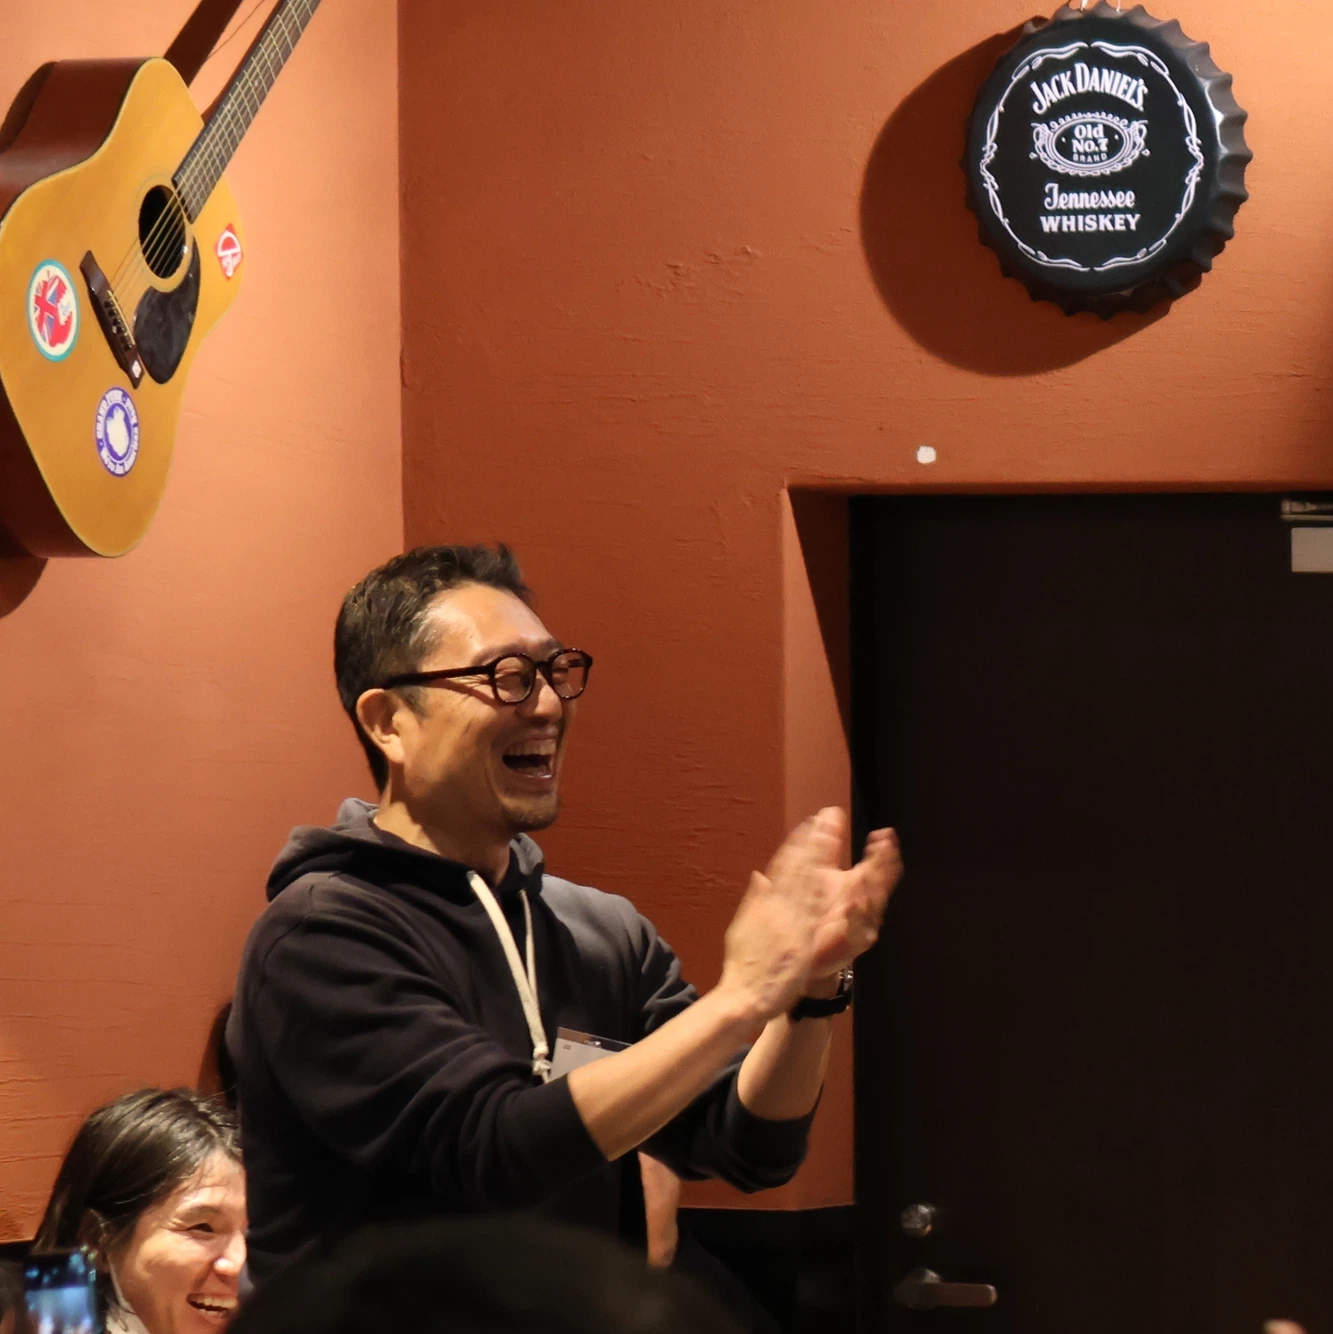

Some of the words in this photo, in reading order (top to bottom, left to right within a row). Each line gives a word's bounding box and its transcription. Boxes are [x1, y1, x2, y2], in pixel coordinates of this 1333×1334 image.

[1030, 70, 1077, 114] JACK
[1074, 124, 1105, 139] Old
[1072, 138, 1109, 153] No.7
[1073, 152, 1108, 162] BRAND
[1044, 182, 1136, 210] Tennessee
[1040, 213, 1141, 233] WHISKEY
